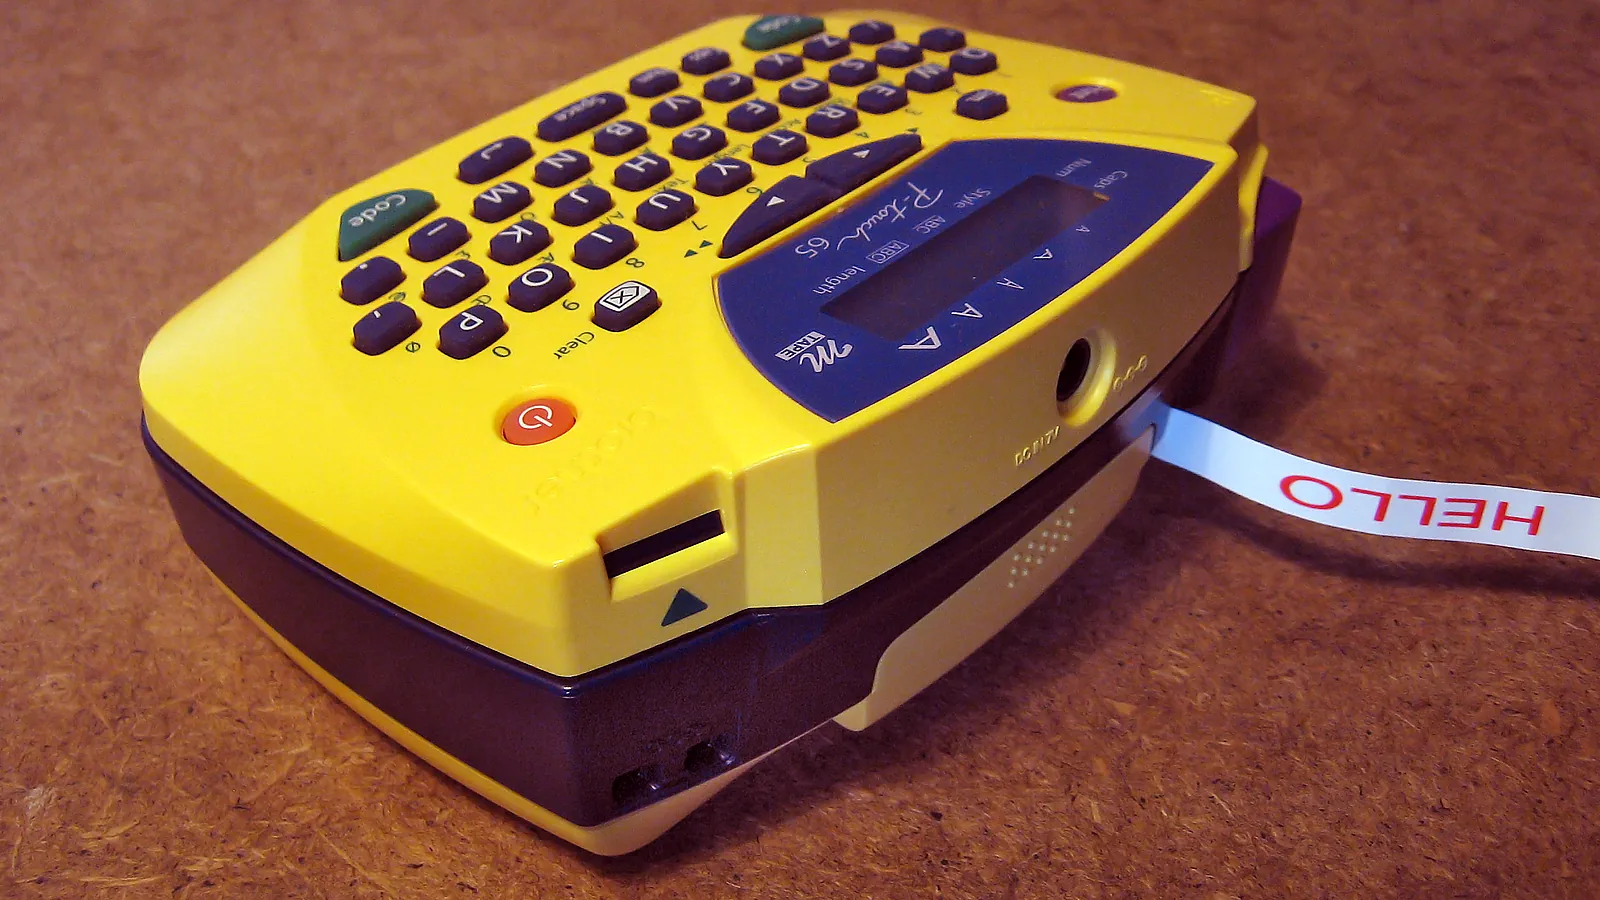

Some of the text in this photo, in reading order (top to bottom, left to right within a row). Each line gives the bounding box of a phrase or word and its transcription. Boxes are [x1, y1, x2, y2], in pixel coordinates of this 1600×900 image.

[790, 80, 818, 92] D
[867, 85, 896, 97] E
[745, 102, 766, 115] F
[816, 107, 847, 119] R
[605, 123, 634, 136] B
[680, 126, 712, 141] G
[767, 133, 795, 146] T
[544, 152, 578, 169] N
[624, 155, 658, 173] H
[711, 160, 740, 176] Y
[1057, 158, 1092, 177] Num
[1095, 170, 1128, 189] Caps
[481, 182, 518, 204] M
[569, 190, 589, 205] J
[649, 192, 681, 210] U
[956, 188, 991, 210] Style
[349, 193, 406, 227] Code
[795, 181, 943, 258] P-touch 65
[912, 215, 946, 234] ABC
[500, 224, 533, 243] K
[1075, 225, 1091, 233] A
[868, 241, 907, 263] ABC
[1033, 248, 1054, 260] A
[433, 265, 466, 278] L
[625, 257, 645, 269] 8
[521, 268, 553, 287] O
[813, 266, 866, 294] length
[996, 278, 1024, 290] A
[562, 299, 580, 311] 9
[951, 302, 984, 319] A
[460, 311, 483, 331] P
[553, 331, 595, 360] Clear
[777, 332, 824, 360] TAPE
[898, 326, 942, 350] A
[1014, 447, 1031, 466] DC
[1280, 475, 1545, 536] HELLO
